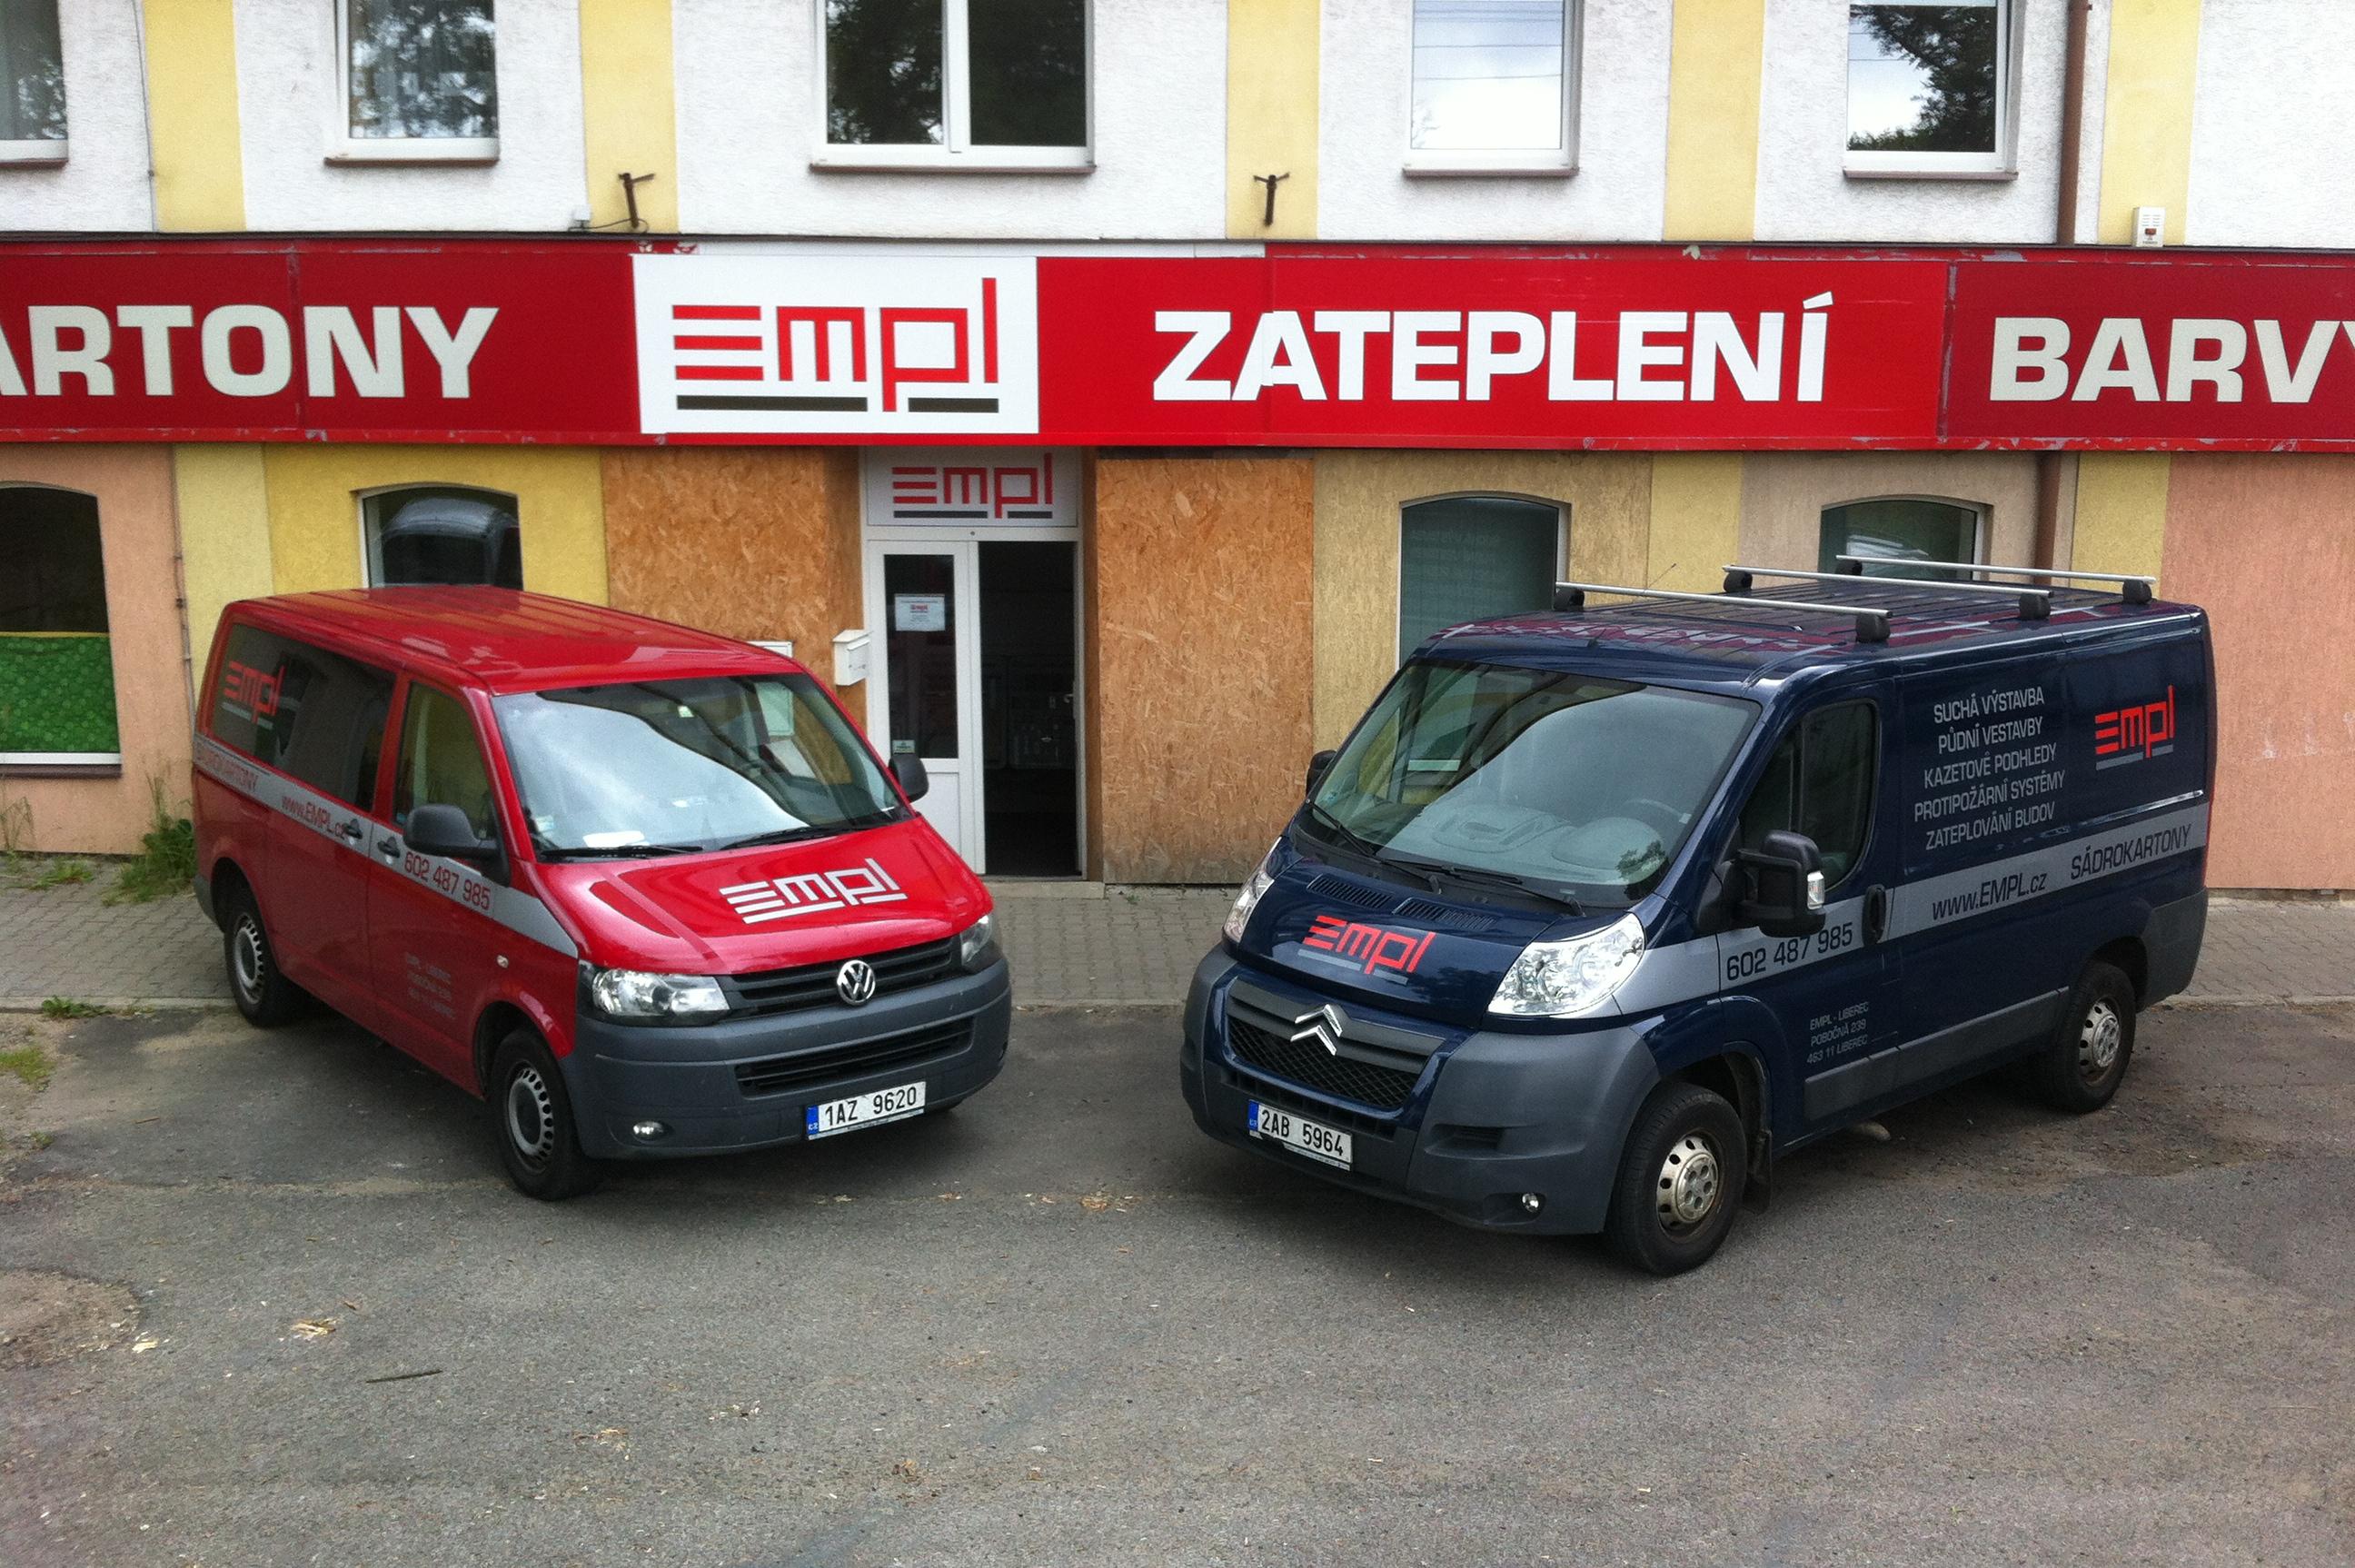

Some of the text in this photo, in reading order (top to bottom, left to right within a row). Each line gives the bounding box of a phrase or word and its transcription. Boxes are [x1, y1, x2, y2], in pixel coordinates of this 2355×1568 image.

[0, 304, 500, 399] RTONY
[1153, 291, 1833, 402] ZATEPLENÍ
[1990, 316, 2355, 403] BARV
[1934, 686, 2044, 724] SUCHÁ VÝSTAVBA
[1938, 716, 2043, 754] PŮDNÍ VESTAVBY
[1994, 742, 2057, 773] PODHLEDY
[1914, 769, 2065, 822] PROTIPOŽÁRNÍ SYSTÉMY
[1925, 801, 2055, 850] ZATEPLOVÁNÍ BUDOV
[404, 851, 491, 909] 602 487 985
[1933, 824, 2191, 920] www.EMPL.cz SÁDROKARTONY
[1727, 922, 1853, 980] 602 487 985
[1838, 1001, 1869, 1020] LIBEREC
[825, 1100, 858, 1126] 1AZ
[873, 1087, 916, 1114] 9620
[1262, 1109, 1289, 1137] 2AB
[1303, 1123, 1343, 1156] 5964
